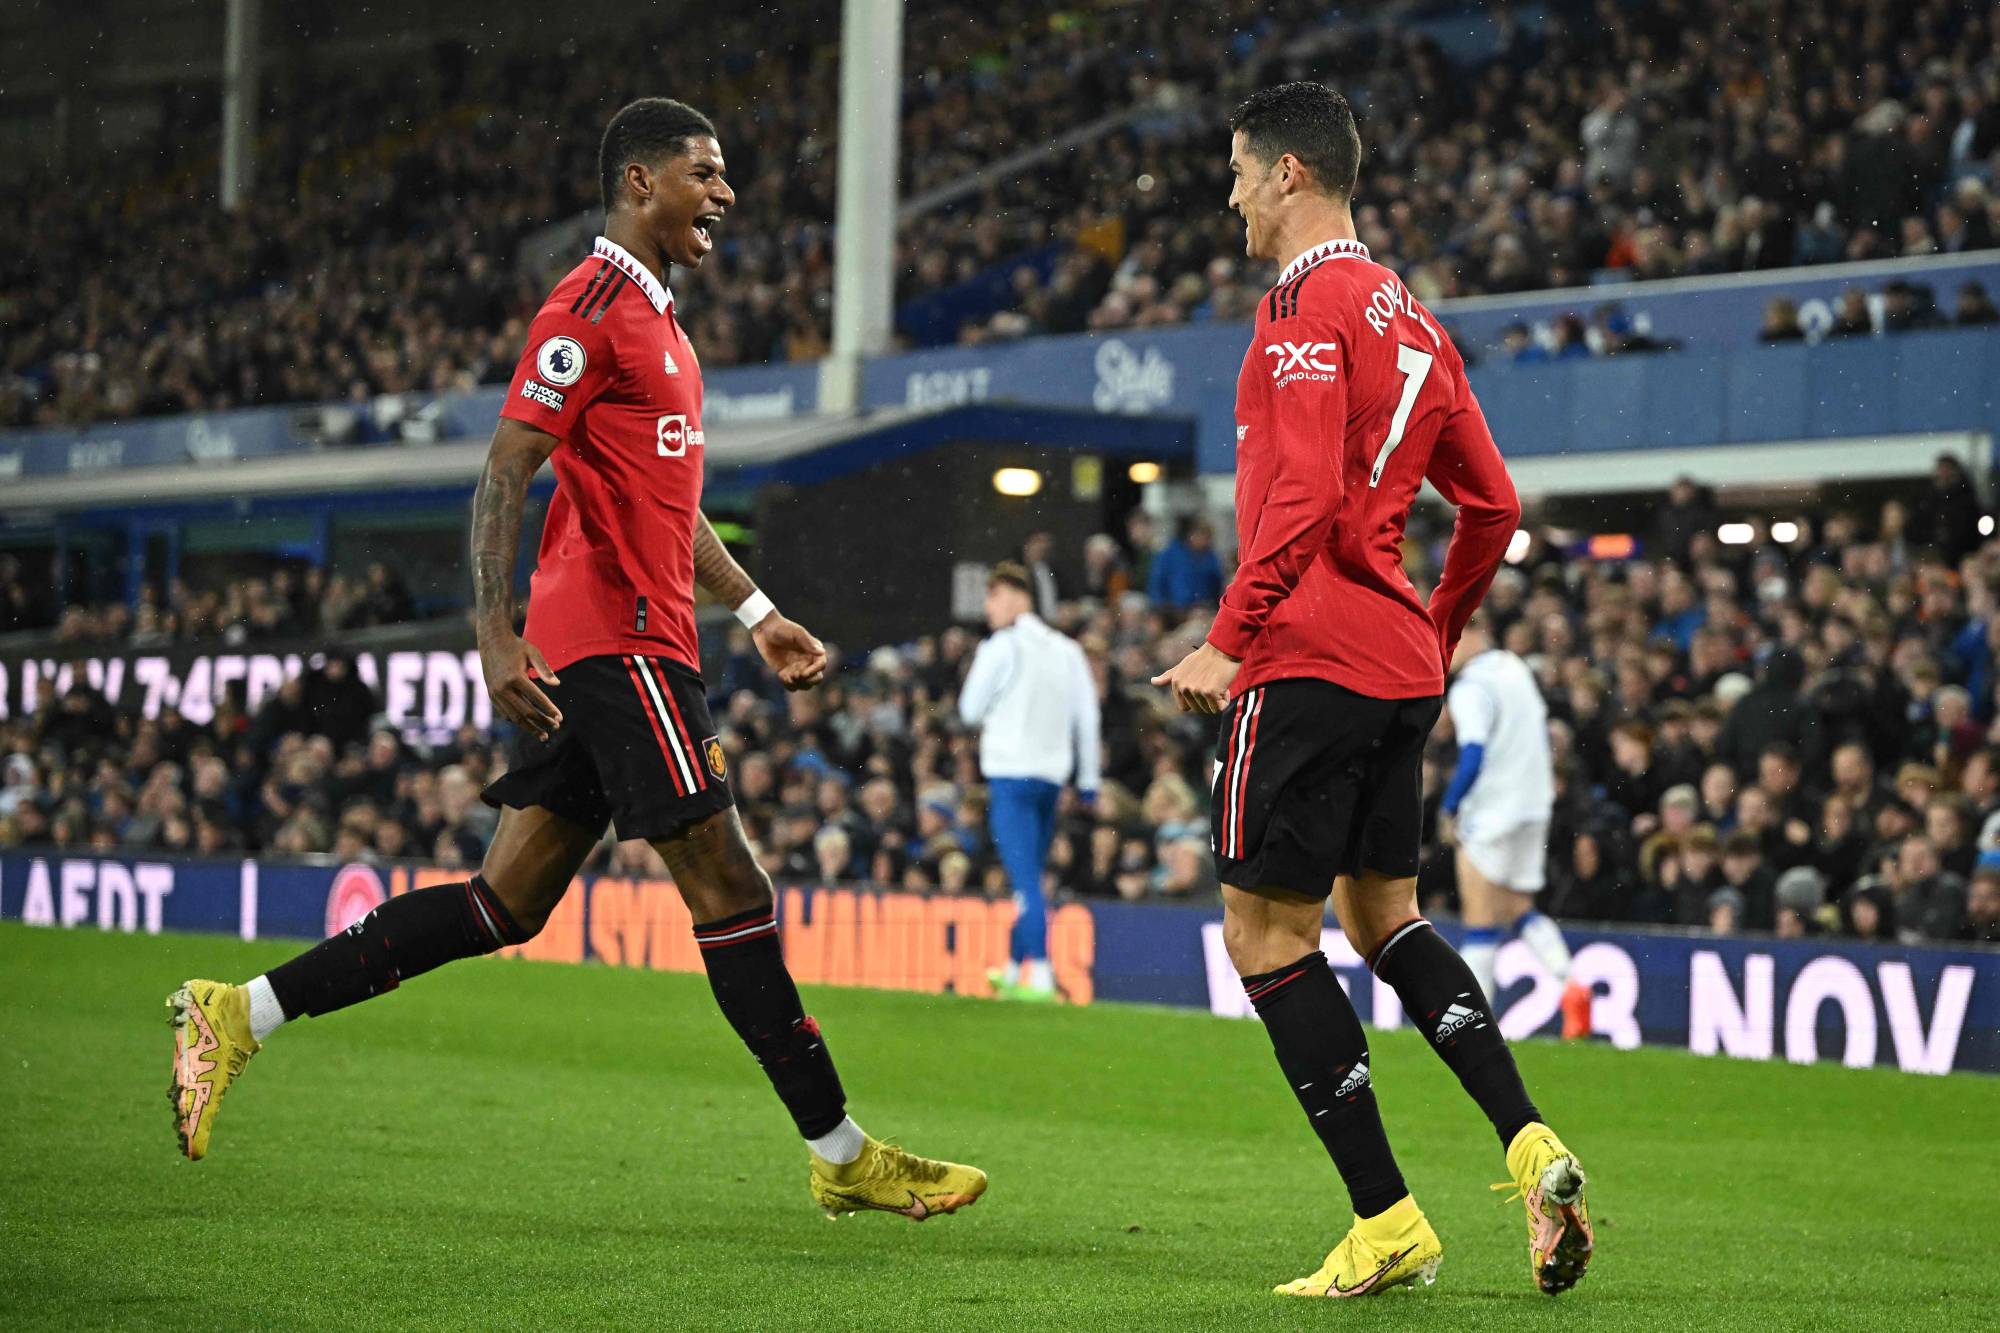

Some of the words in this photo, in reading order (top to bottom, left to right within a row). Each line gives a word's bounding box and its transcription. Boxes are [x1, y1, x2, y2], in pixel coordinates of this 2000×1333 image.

[521, 388, 535, 399] for
[533, 391, 563, 413] racism
[524, 379, 538, 391] No
[538, 385, 564, 403] room
[1369, 342, 1433, 489] 7
[1435, 1010, 1485, 1044] adidas
[1689, 950, 1976, 1076] NOV
